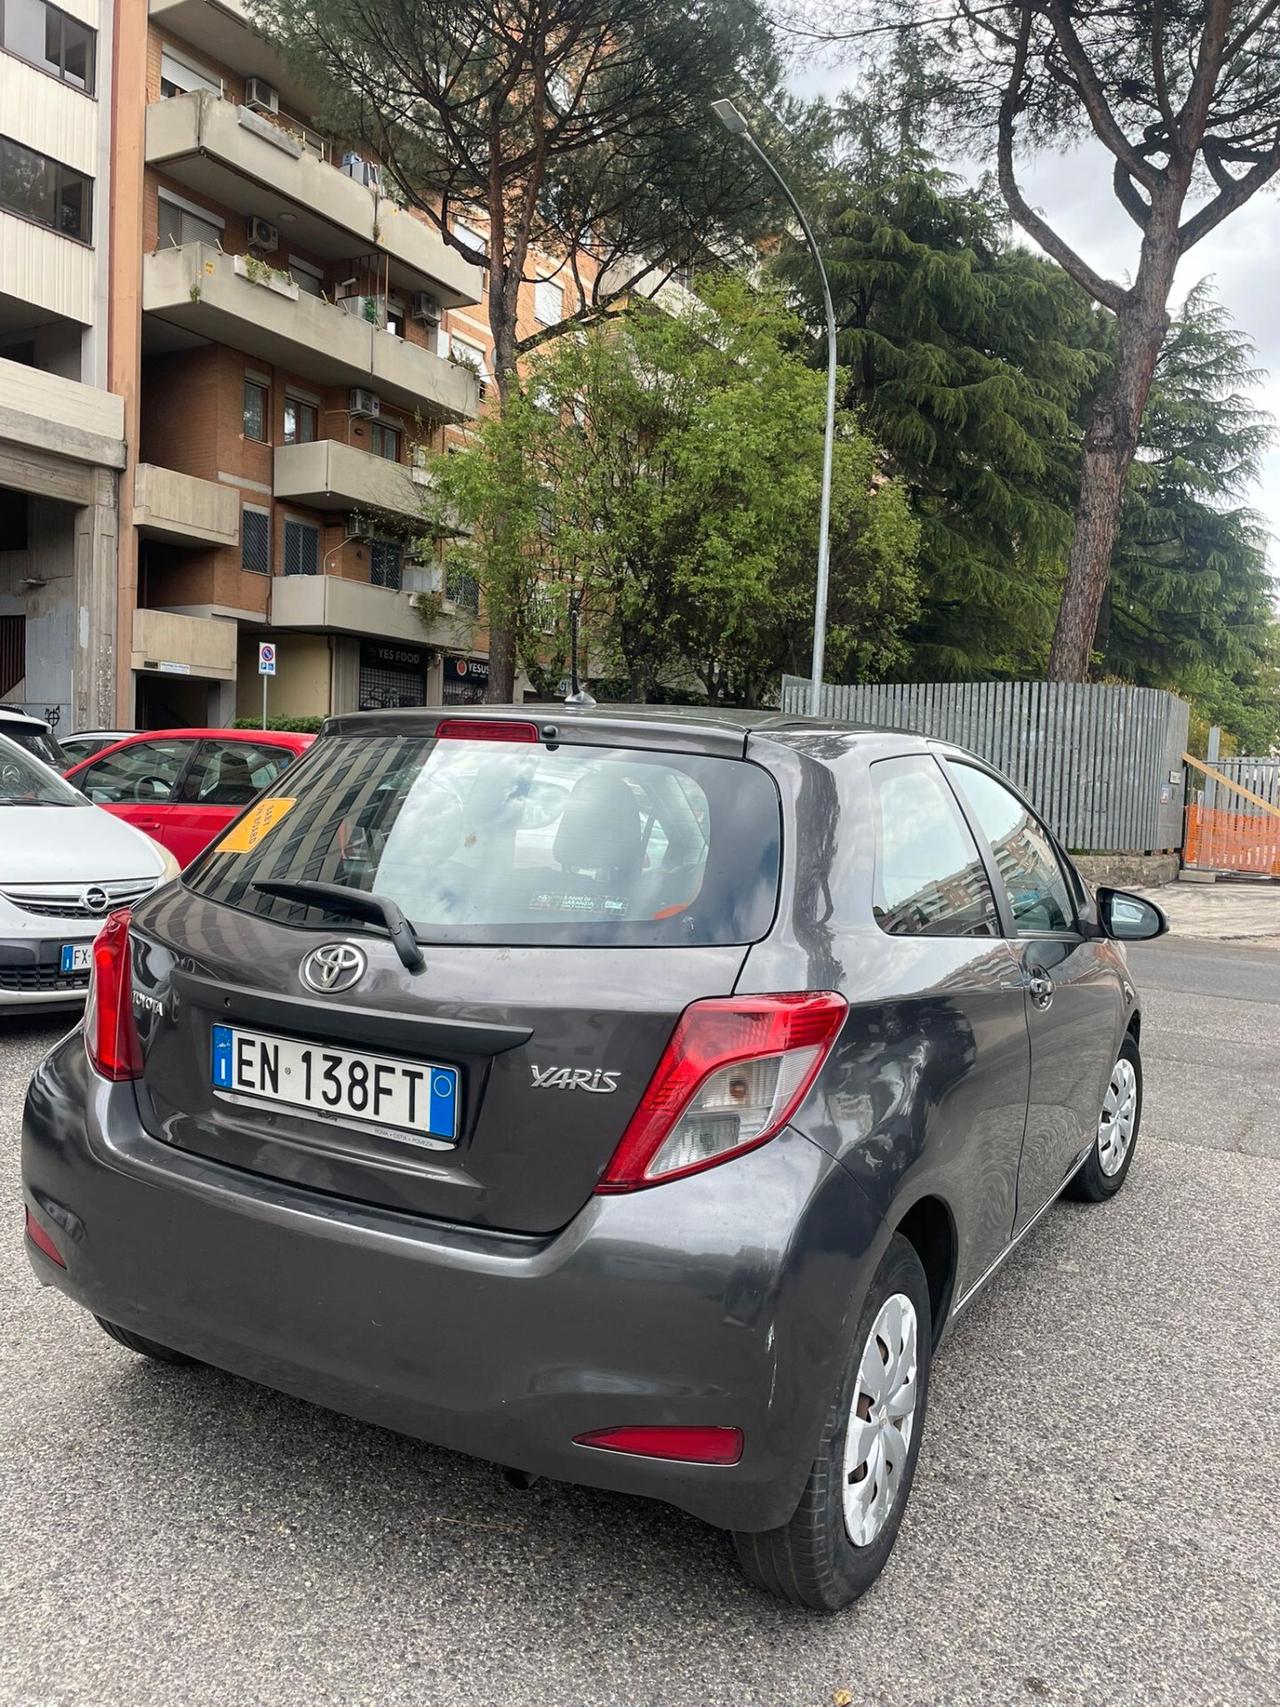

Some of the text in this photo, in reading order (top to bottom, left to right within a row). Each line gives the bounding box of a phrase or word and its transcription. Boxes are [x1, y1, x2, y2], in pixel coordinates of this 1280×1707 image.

[378, 649, 420, 664] YES FOOD
[74, 949, 88, 966] FX
[132, 990, 164, 1017] TOYOTA
[237, 1037, 424, 1123] EN 138FT
